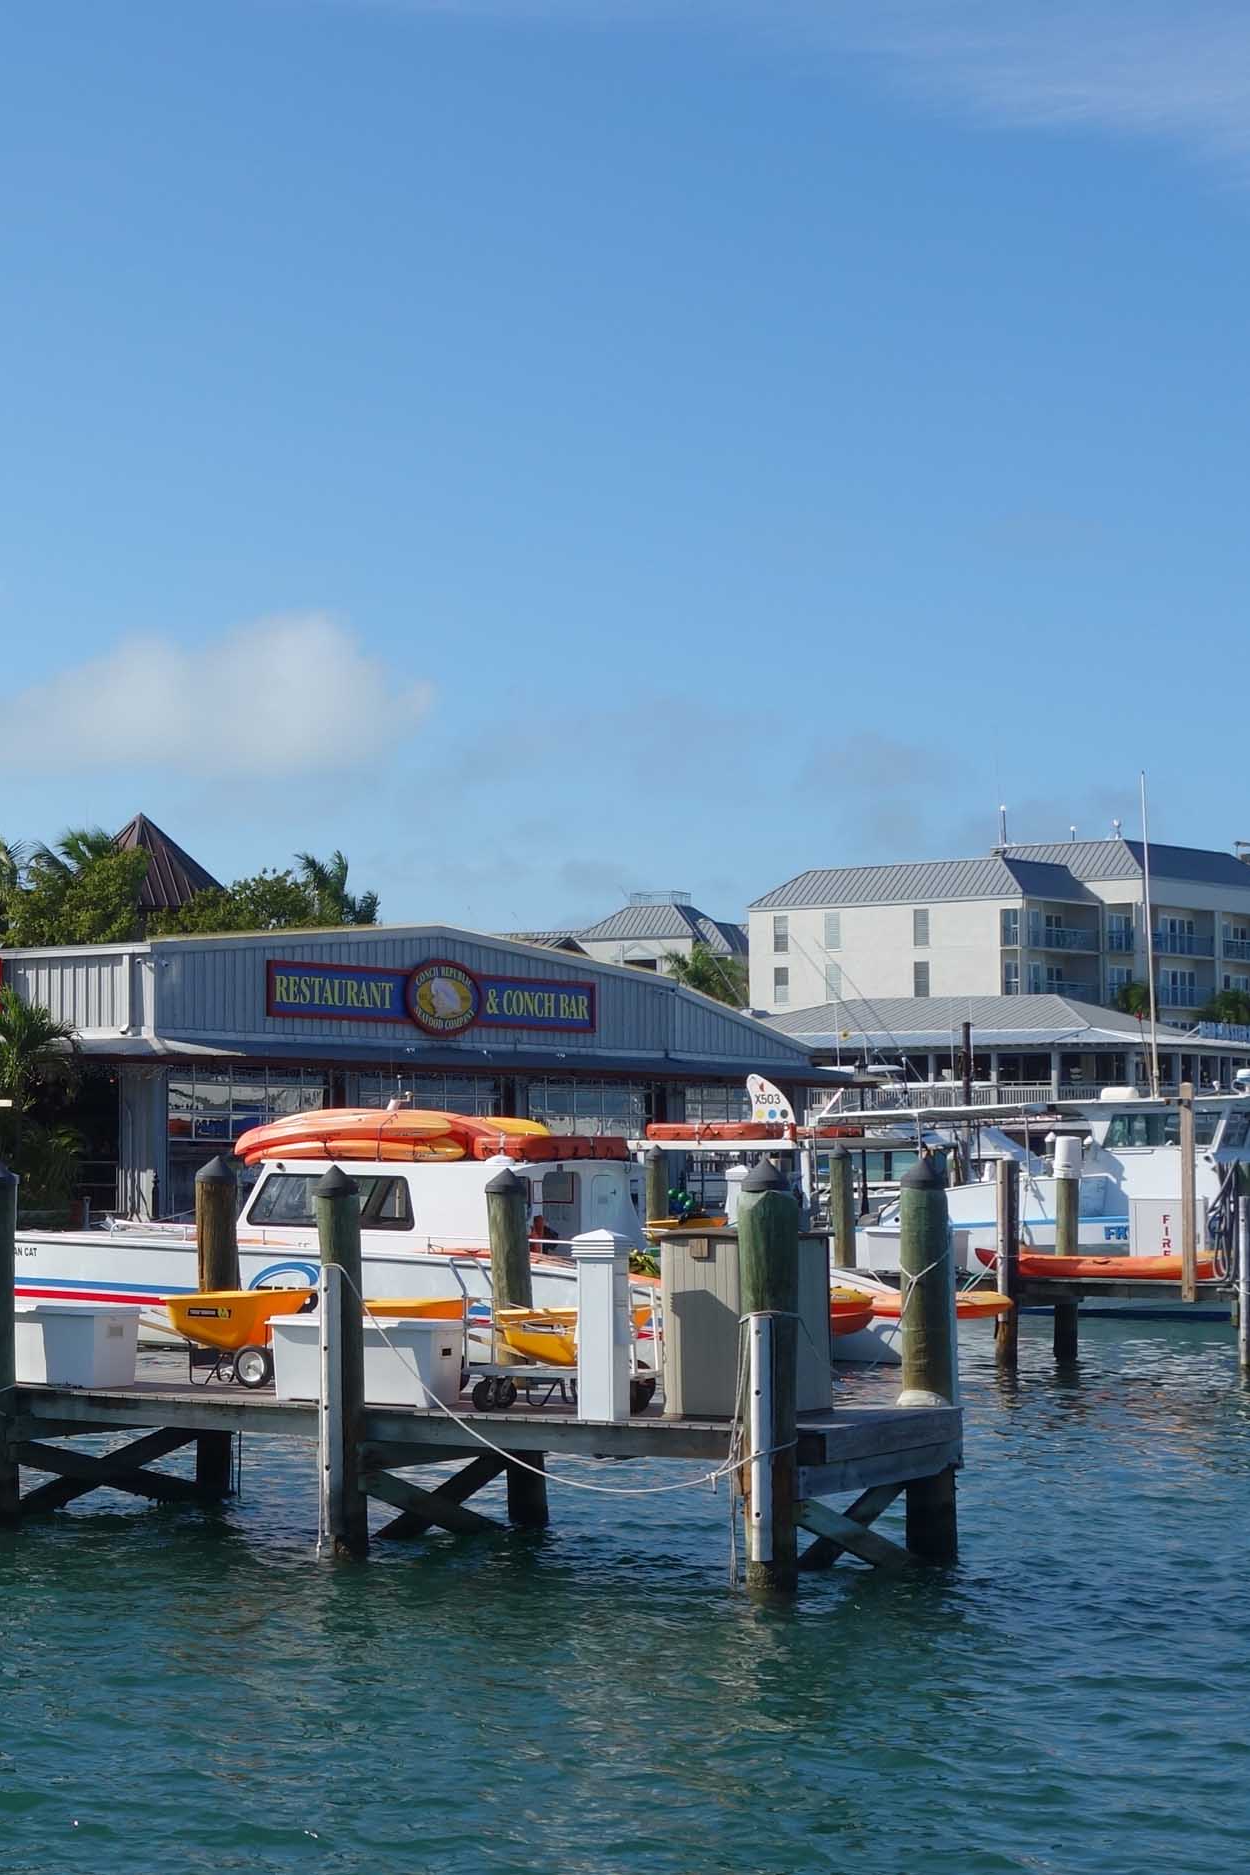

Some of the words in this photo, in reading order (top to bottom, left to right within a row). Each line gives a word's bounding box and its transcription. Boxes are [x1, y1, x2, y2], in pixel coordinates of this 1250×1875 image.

[415, 967, 440, 986] CONCH
[275, 975, 394, 1009] RESTAURANT
[486, 988, 499, 1015] &
[503, 990, 556, 1018] CONCH
[559, 993, 589, 1020] BAR
[754, 1093, 781, 1105] X503
[24, 1247, 38, 1257] CAT
